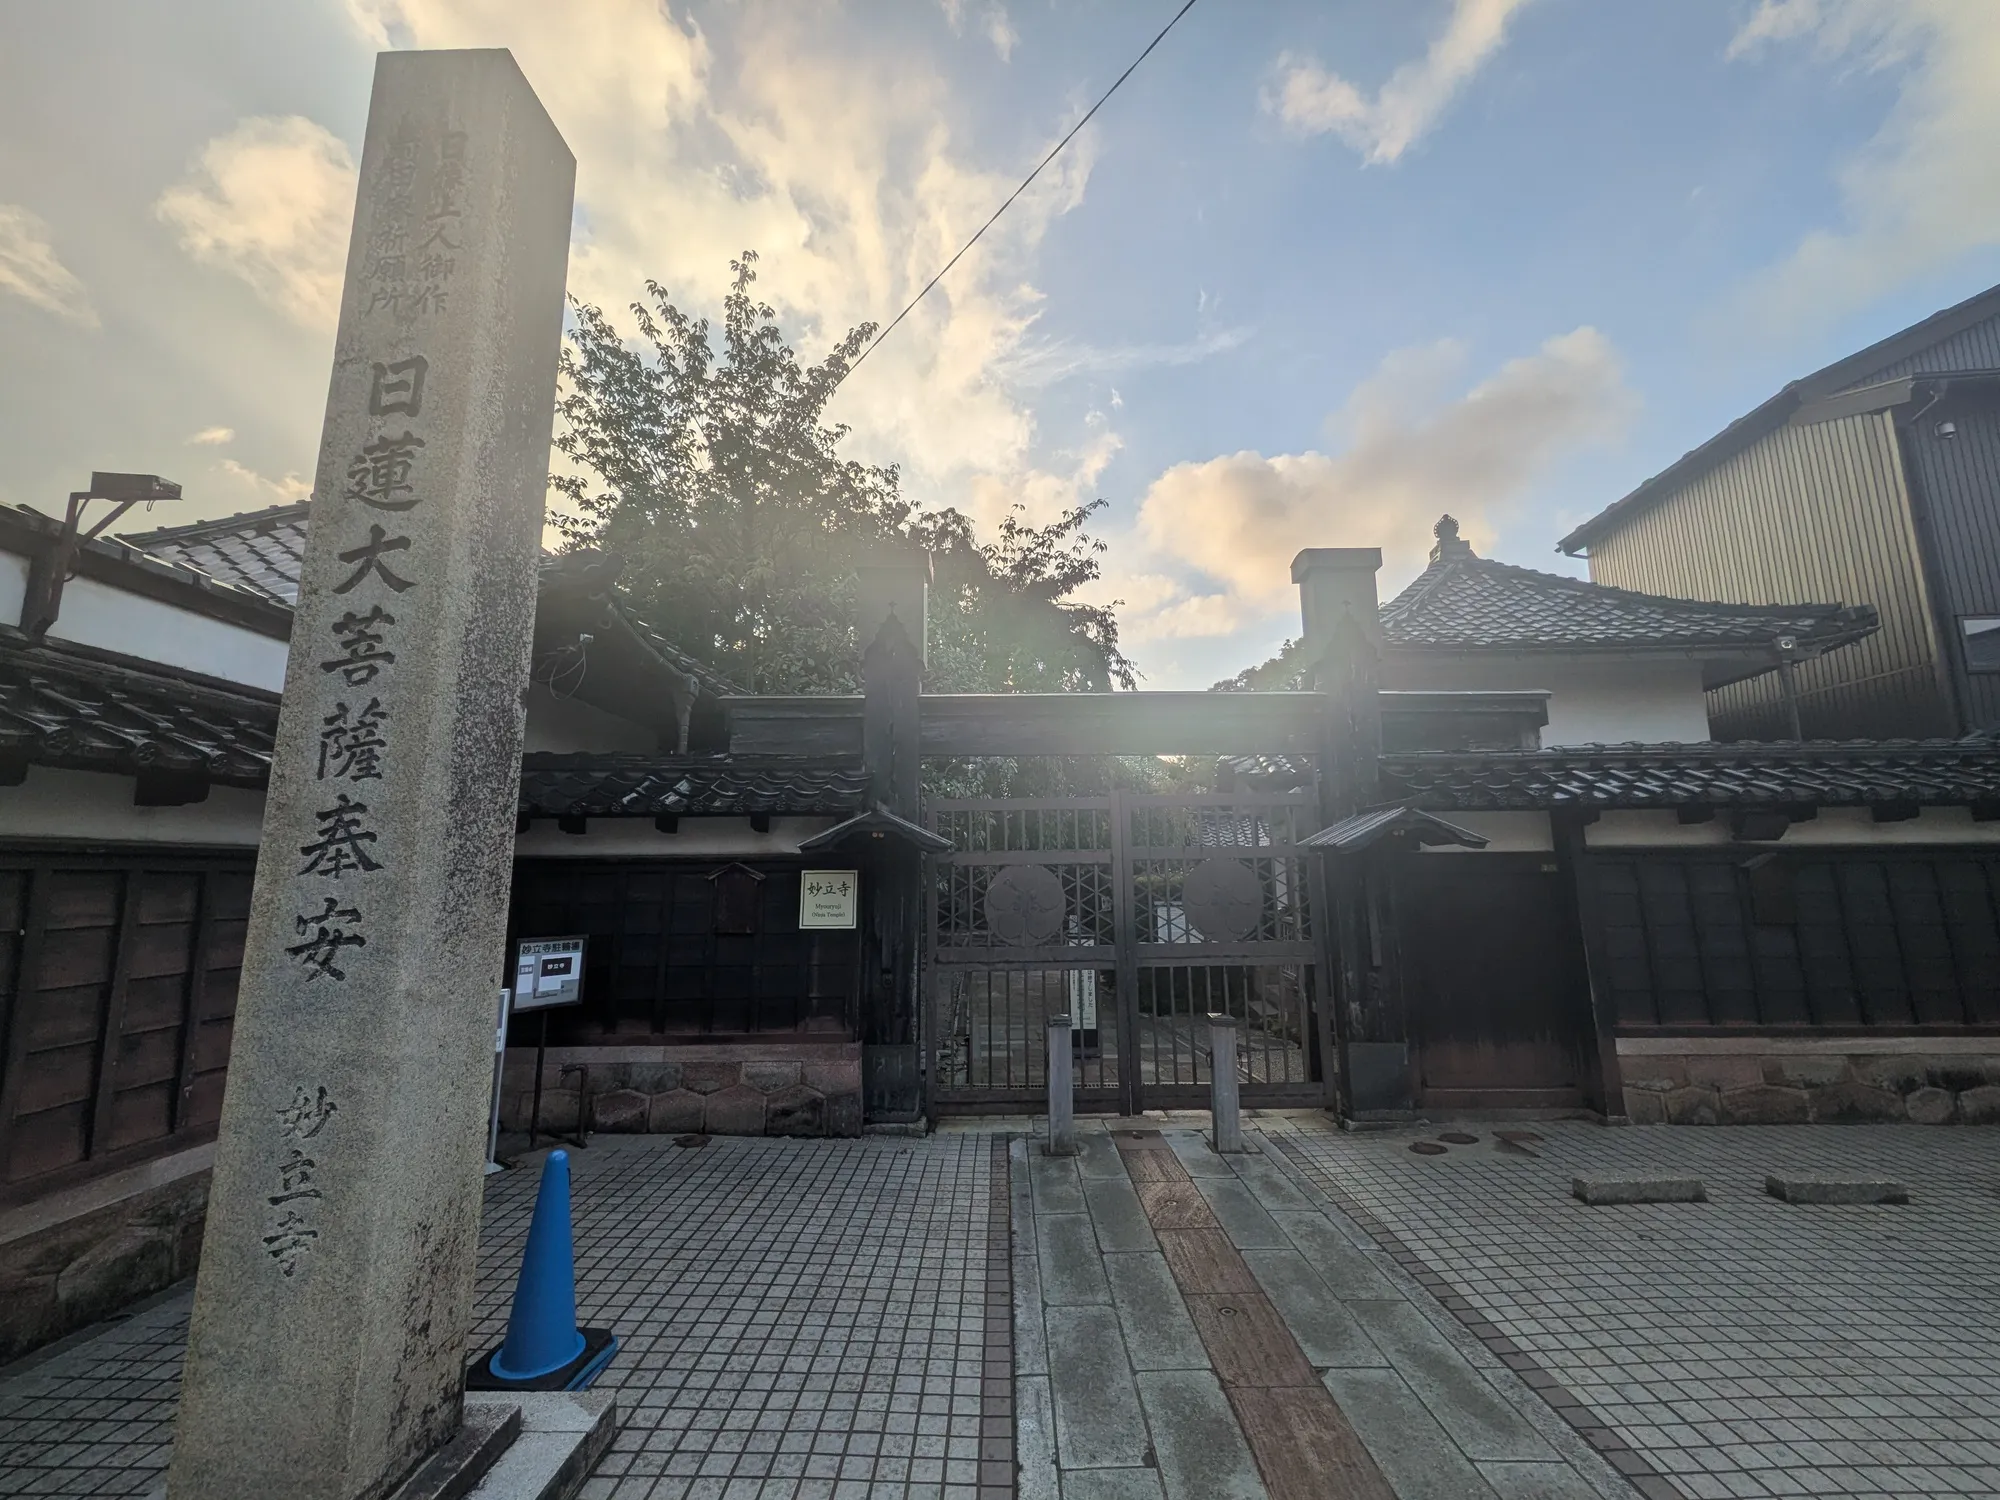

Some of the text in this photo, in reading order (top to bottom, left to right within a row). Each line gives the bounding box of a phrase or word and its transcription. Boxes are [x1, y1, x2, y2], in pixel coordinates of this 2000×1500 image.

[284, 354, 429, 983] 日蓮大菩薩奉安
[807, 880, 851, 897] 妙立寺
[262, 1085, 338, 1278] 妙立寺
